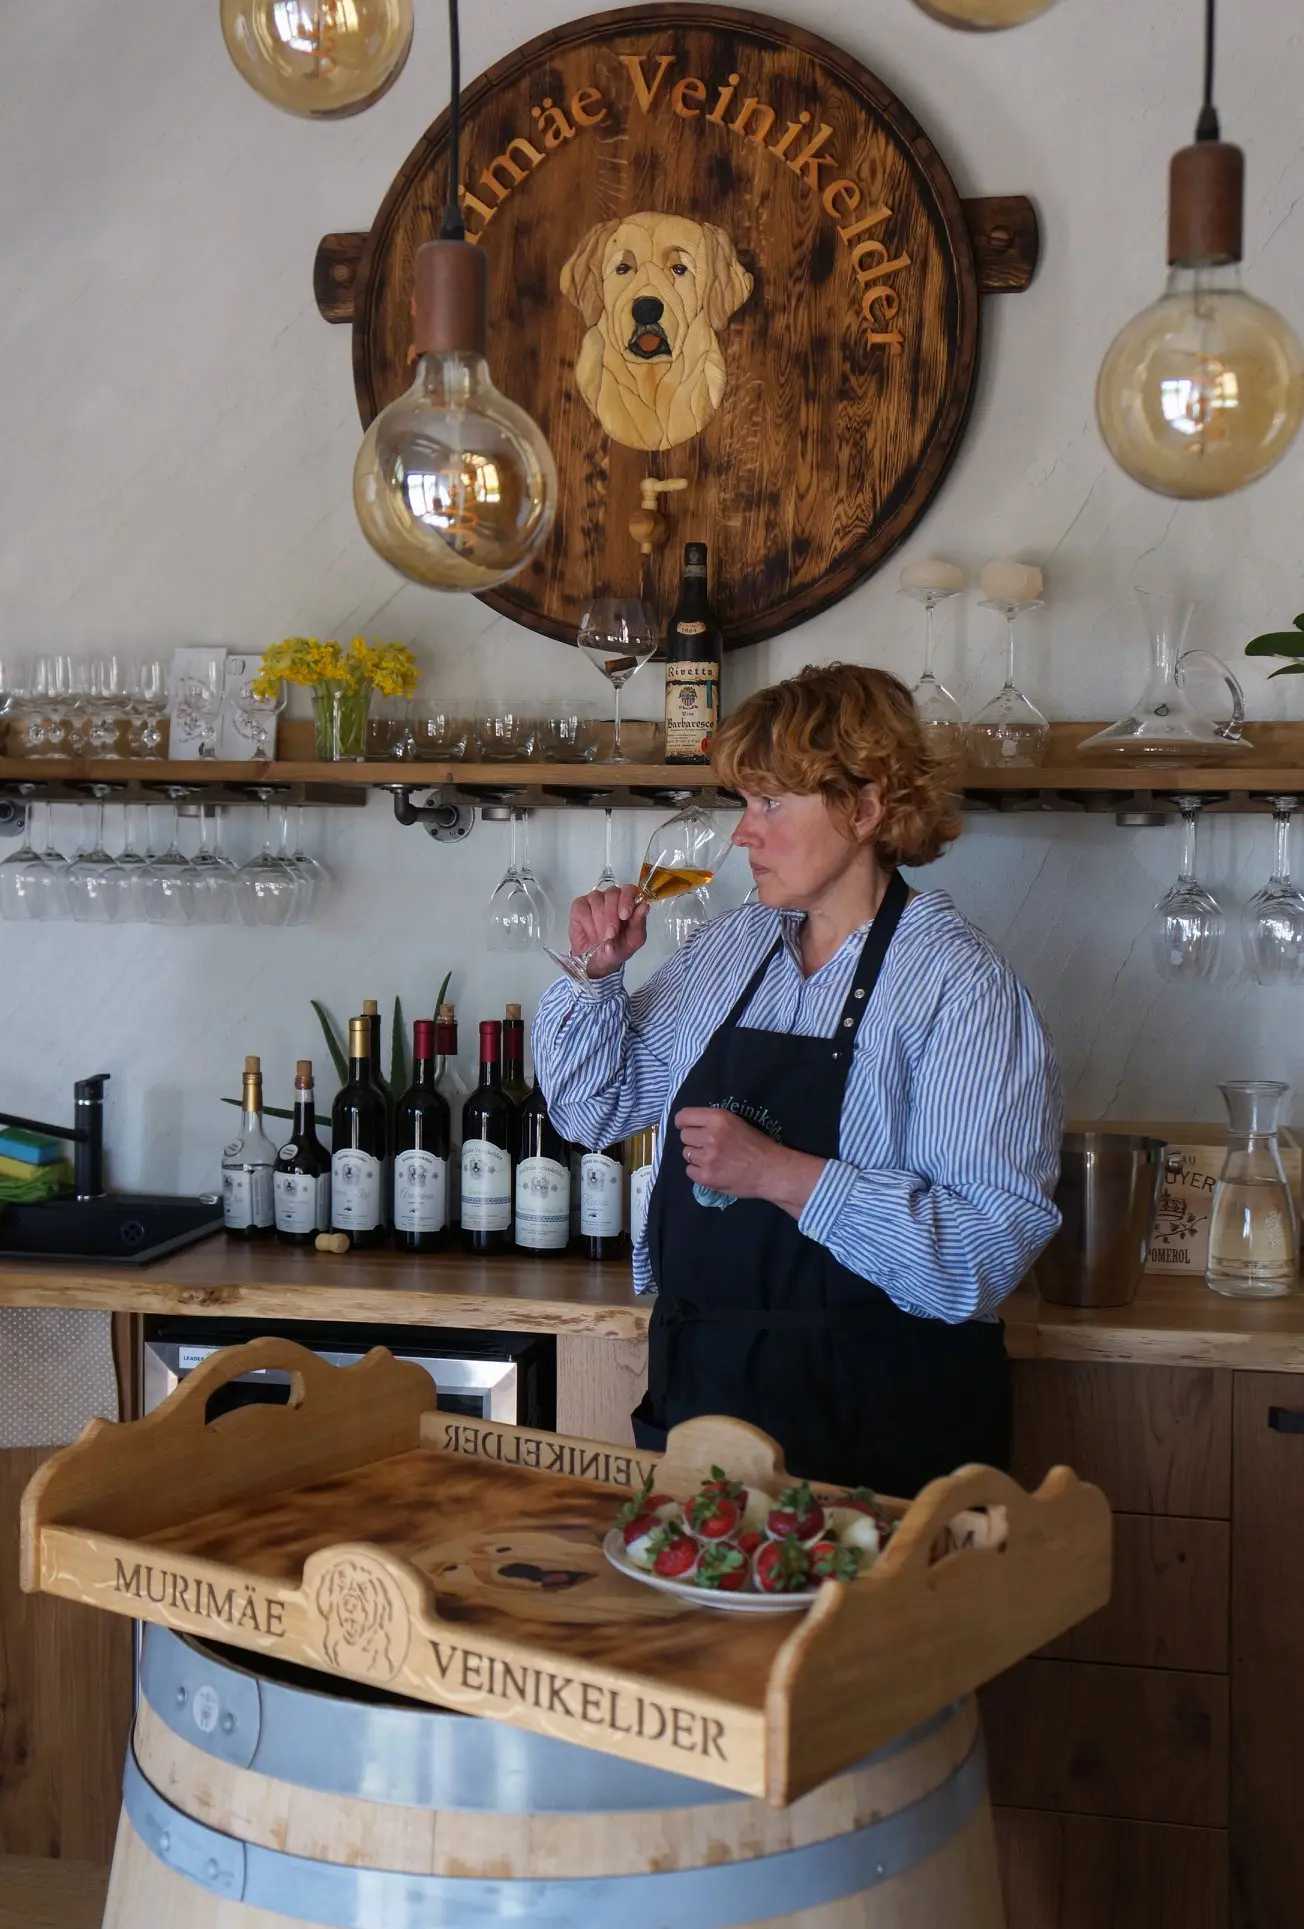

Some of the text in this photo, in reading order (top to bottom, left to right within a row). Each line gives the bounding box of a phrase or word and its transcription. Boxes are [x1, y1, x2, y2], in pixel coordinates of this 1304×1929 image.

[618, 54, 912, 358] Veinikelder
[666, 717, 714, 729] Barbaresco
[113, 1557, 729, 1762] MURIMÄE VEINIKELDER
